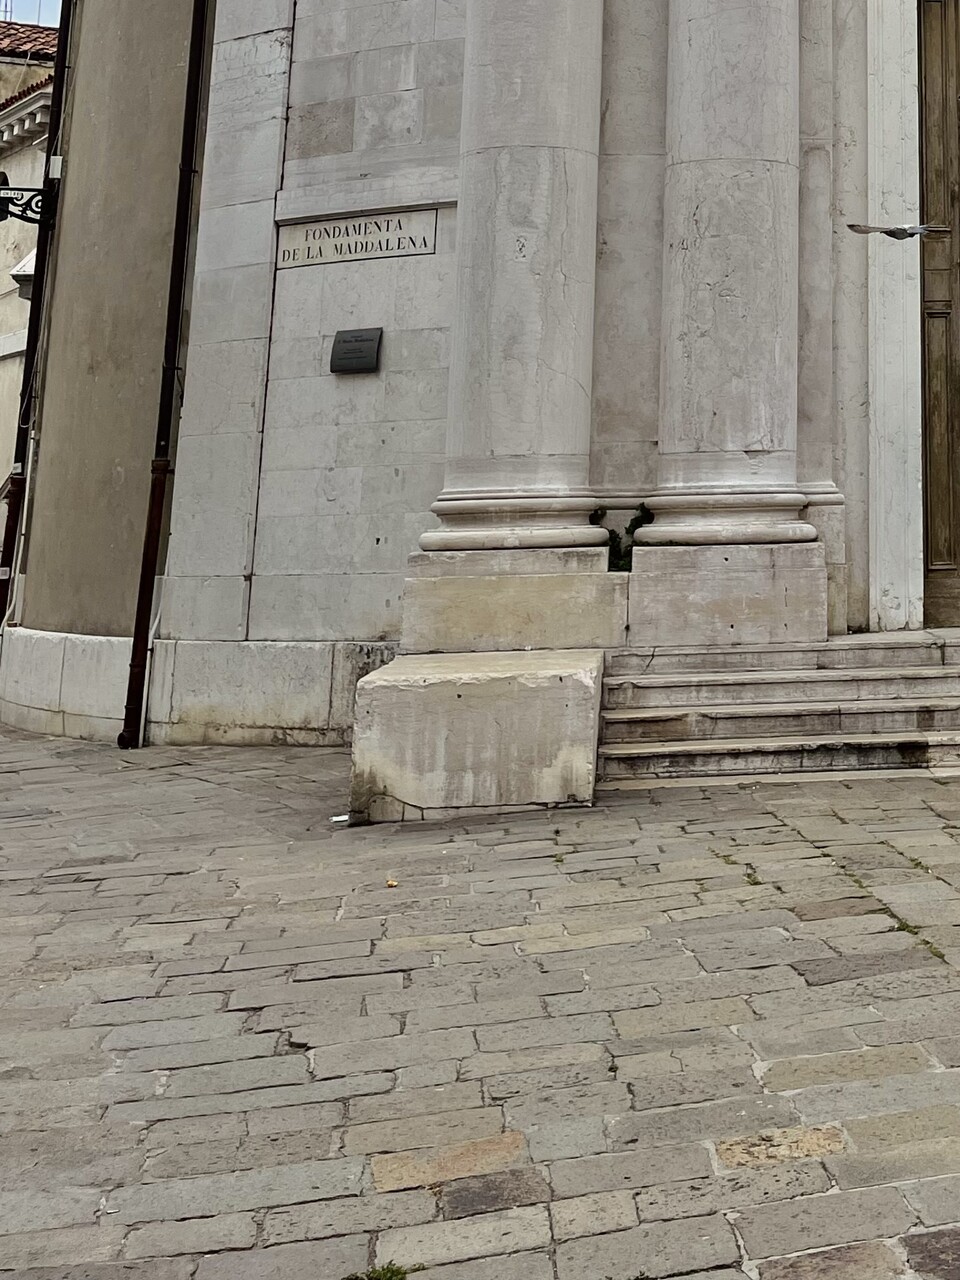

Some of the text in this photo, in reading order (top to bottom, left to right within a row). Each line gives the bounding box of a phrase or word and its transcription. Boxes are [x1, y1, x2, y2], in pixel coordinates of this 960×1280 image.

[304, 218, 403, 242] FONDAMENTA
[282, 235, 428, 262] DE LA MADDALENA
